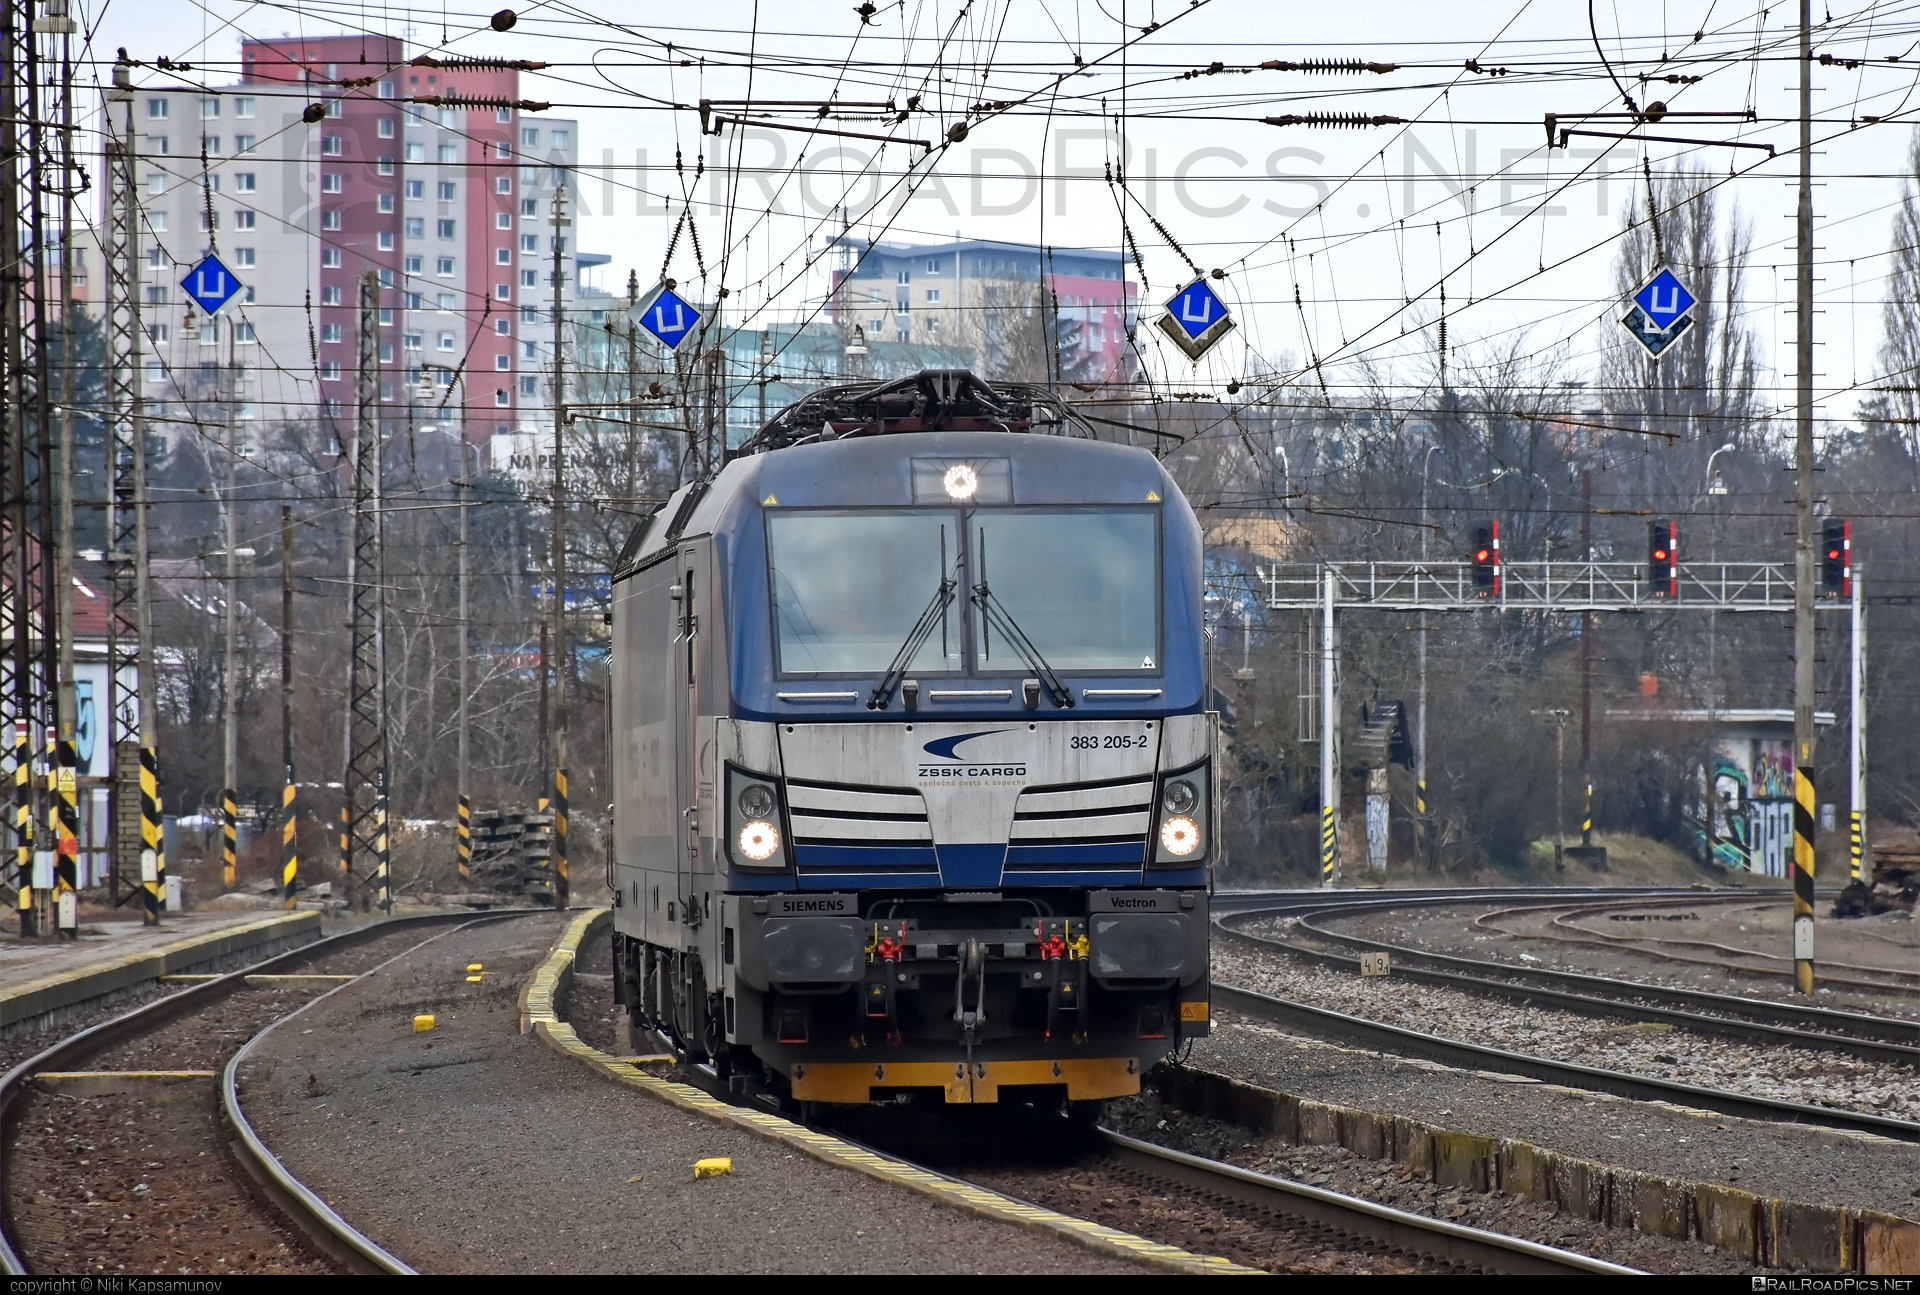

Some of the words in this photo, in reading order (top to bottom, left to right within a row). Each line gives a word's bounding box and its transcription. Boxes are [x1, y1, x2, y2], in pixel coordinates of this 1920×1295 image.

[1070, 735, 1099, 750] 383
[1102, 735, 1148, 749] 205-2
[918, 767, 966, 777] ZSSK
[967, 767, 1027, 777] CARGO
[958, 780, 981, 788] cesta
[991, 778, 1027, 788] úspechu
[783, 899, 845, 912] SIEMENS
[1110, 896, 1157, 909] Vectron
